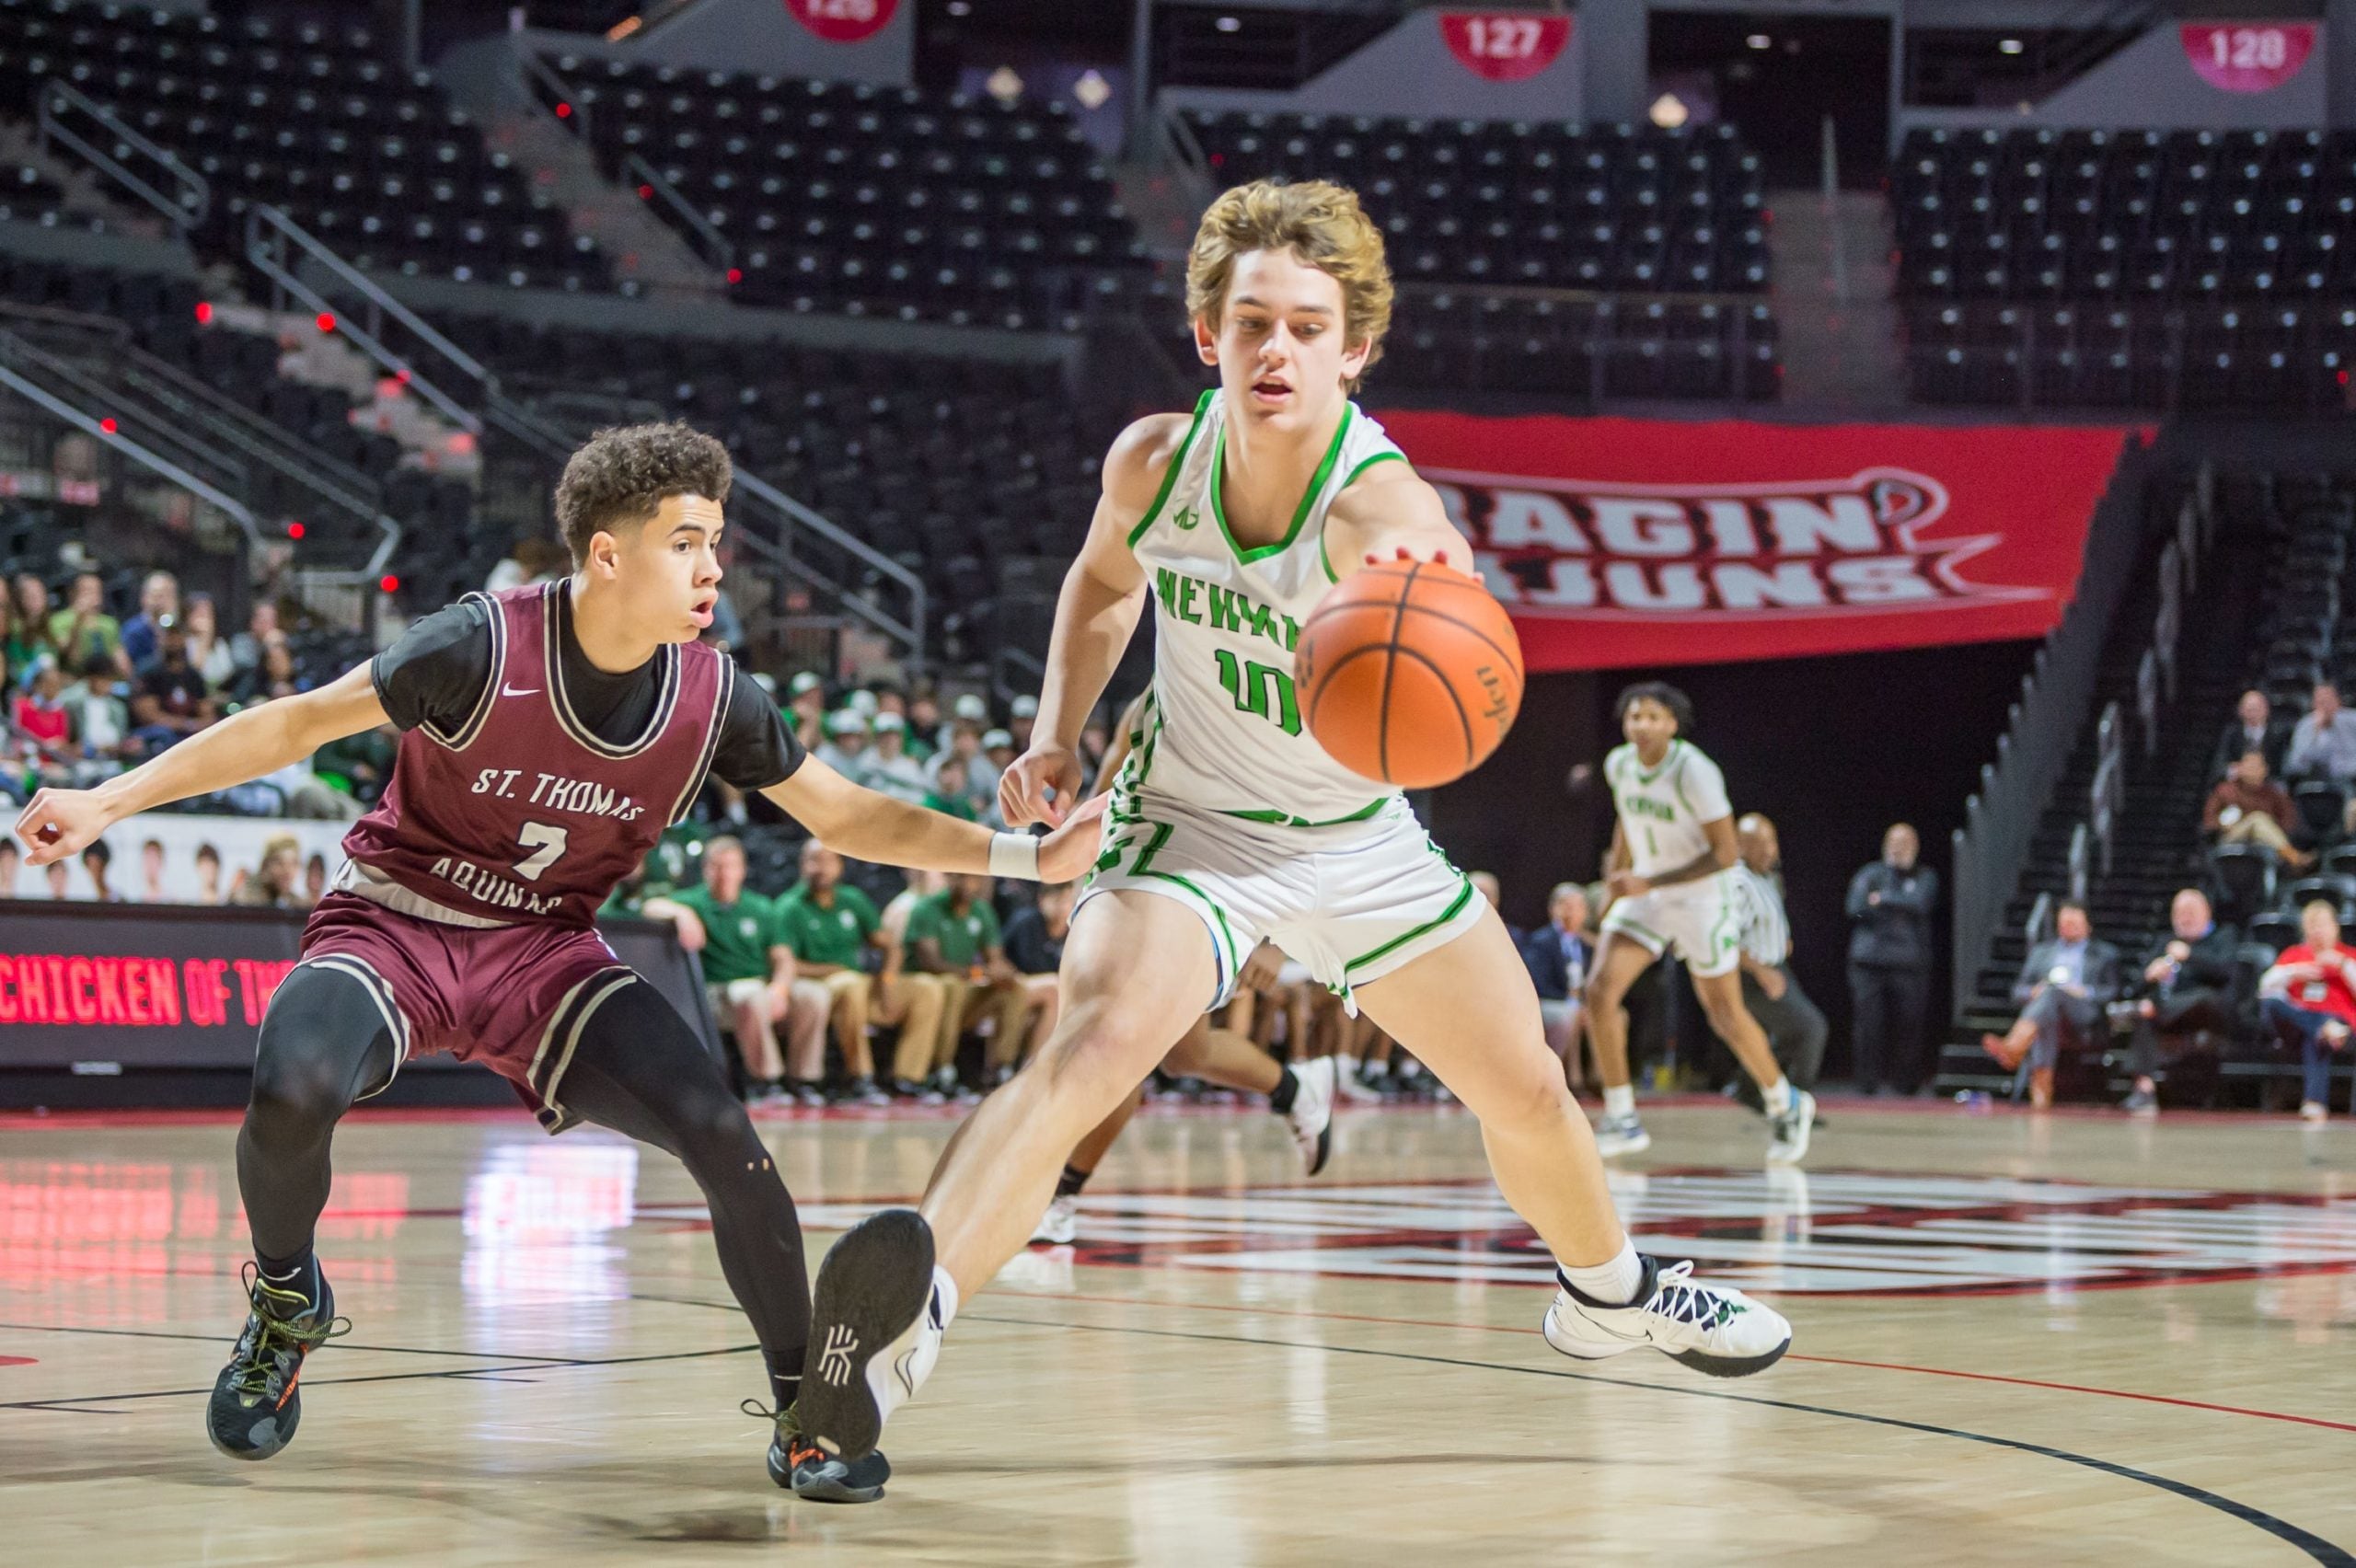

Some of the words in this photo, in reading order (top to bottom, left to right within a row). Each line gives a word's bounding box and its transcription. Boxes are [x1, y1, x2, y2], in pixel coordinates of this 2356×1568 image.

[1465, 17, 1542, 59] 127
[1214, 648, 1303, 737] 10
[470, 768, 523, 799] ST.
[512, 820, 569, 882] 7
[0, 953, 182, 1026] CHICKEN
[184, 957, 232, 1027] OF
